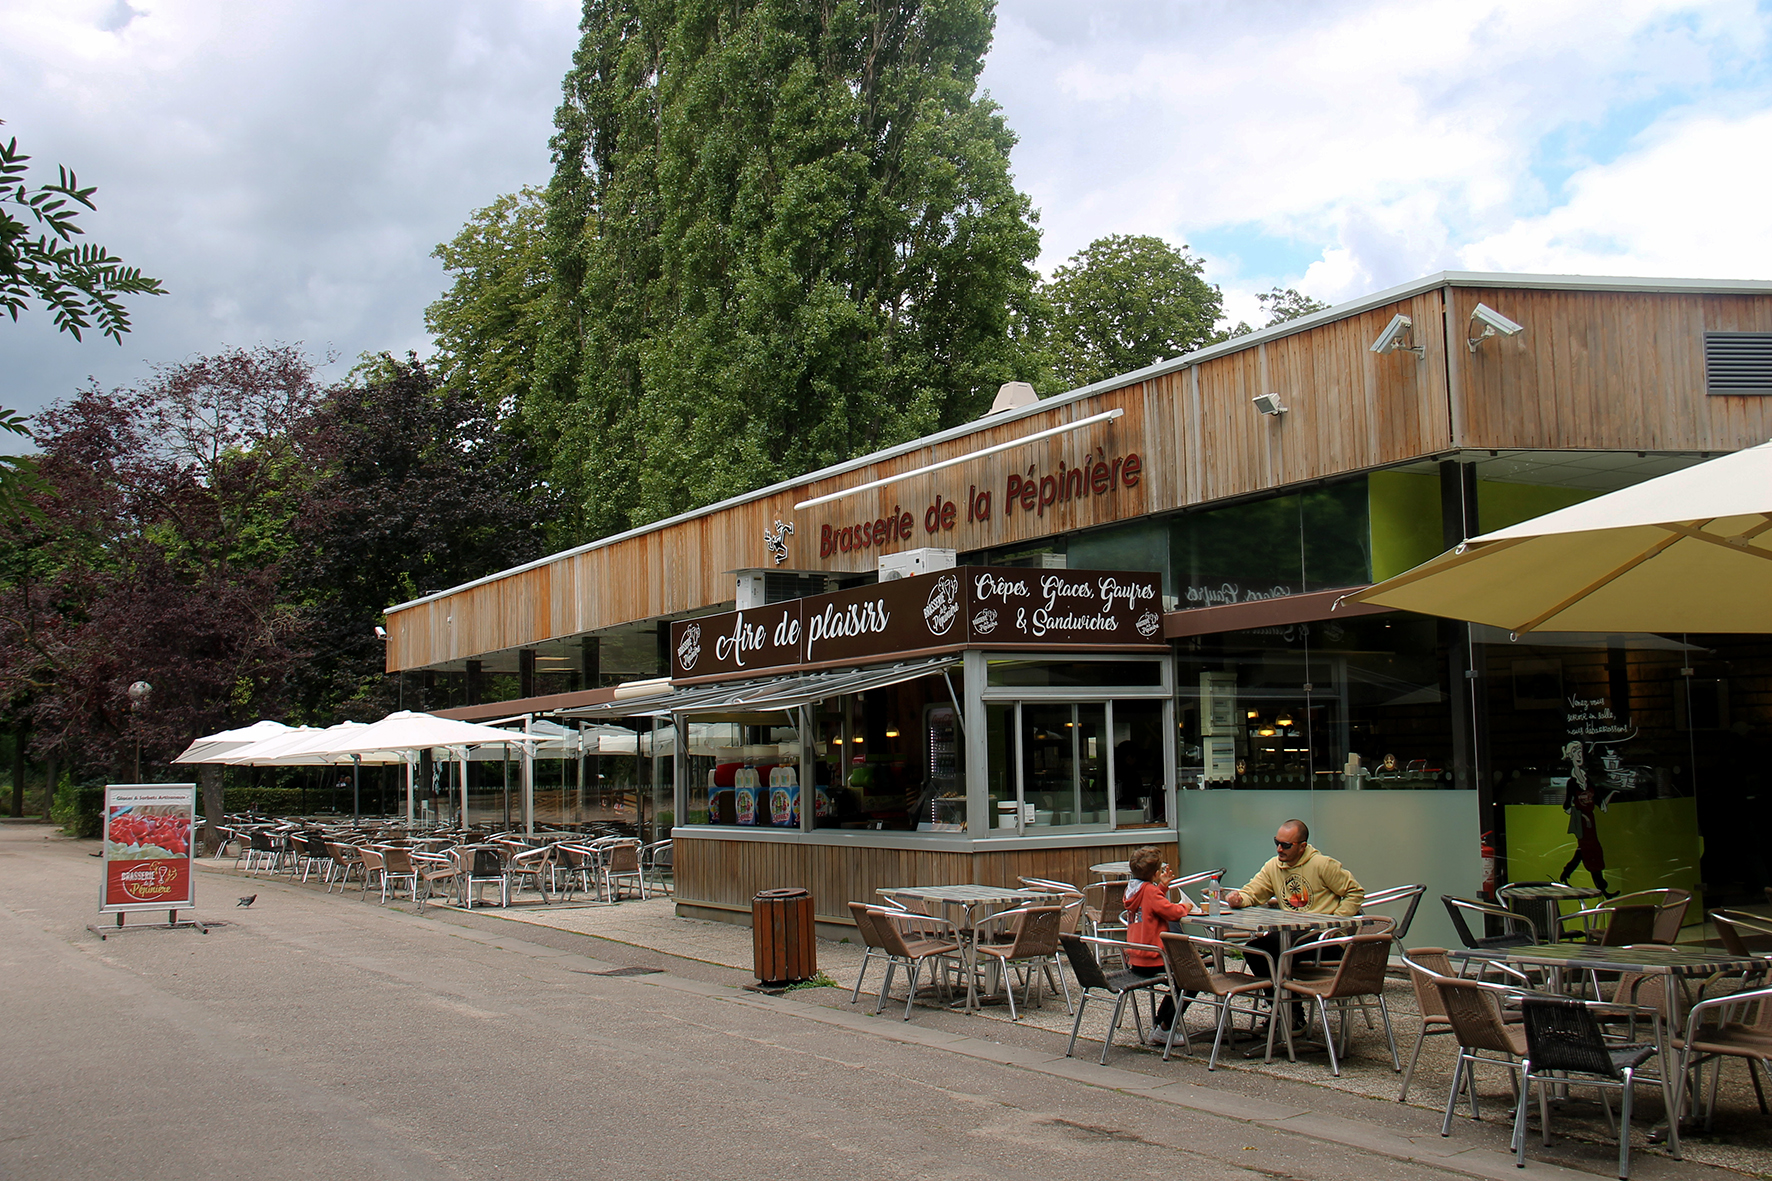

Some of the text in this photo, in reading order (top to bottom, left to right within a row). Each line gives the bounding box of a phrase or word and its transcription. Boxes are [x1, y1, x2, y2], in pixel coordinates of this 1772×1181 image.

[820, 447, 1142, 558] Brasserie de la Pépinière
[974, 572, 1155, 613] Crêpes, Glaces, Gaufres
[716, 612, 767, 667] Aire
[774, 610, 800, 647] de
[807, 598, 890, 661] plaisirs
[1016, 607, 1028, 634] &
[1032, 608, 1119, 637] Sandwiches
[121, 871, 155, 881] BRASSERIE
